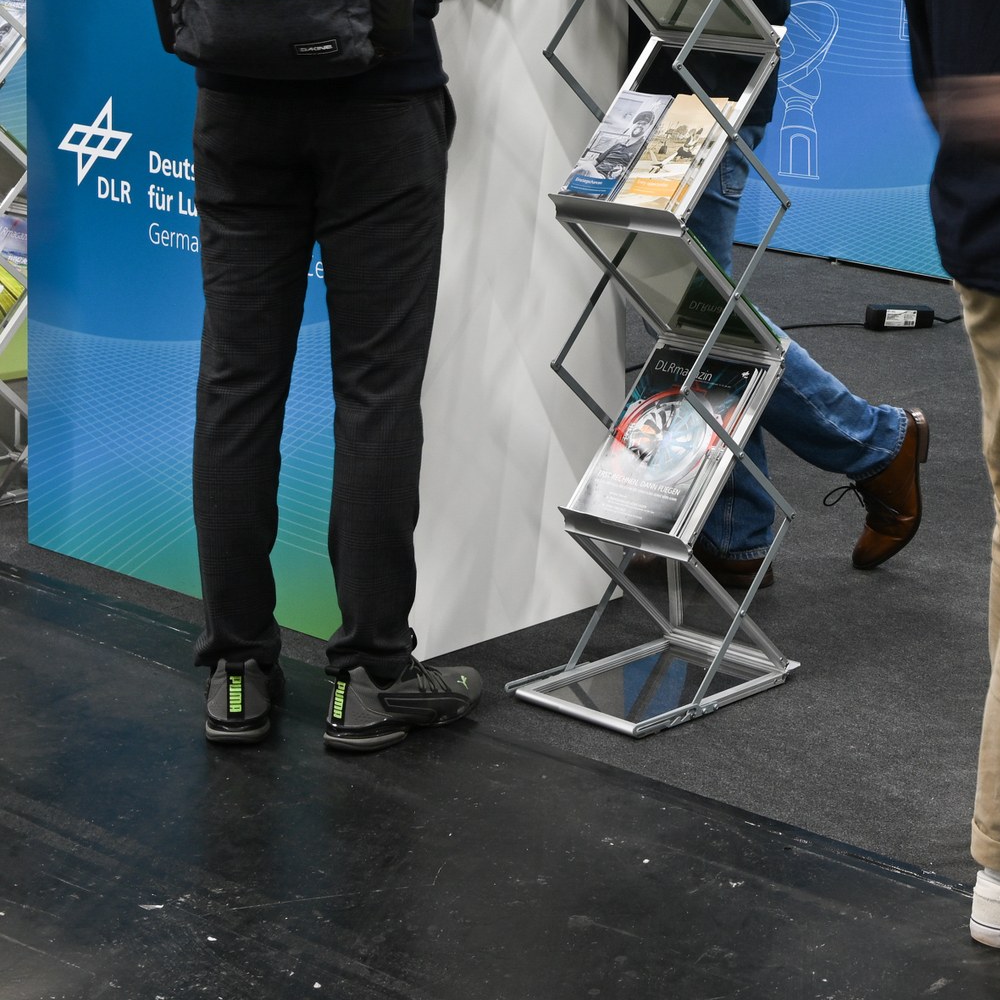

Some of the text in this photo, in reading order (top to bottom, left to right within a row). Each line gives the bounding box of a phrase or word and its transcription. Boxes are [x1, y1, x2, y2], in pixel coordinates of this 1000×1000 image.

[97, 176, 132, 204] DLR
[148, 184, 173, 212] für
[655, 360, 713, 382] DLRmazin
[640, 481, 658, 490] DANN
[658, 485, 681, 496] FLIEGEN
[229, 676, 242, 713] PUMA
[333, 681, 346, 719] PUMA
